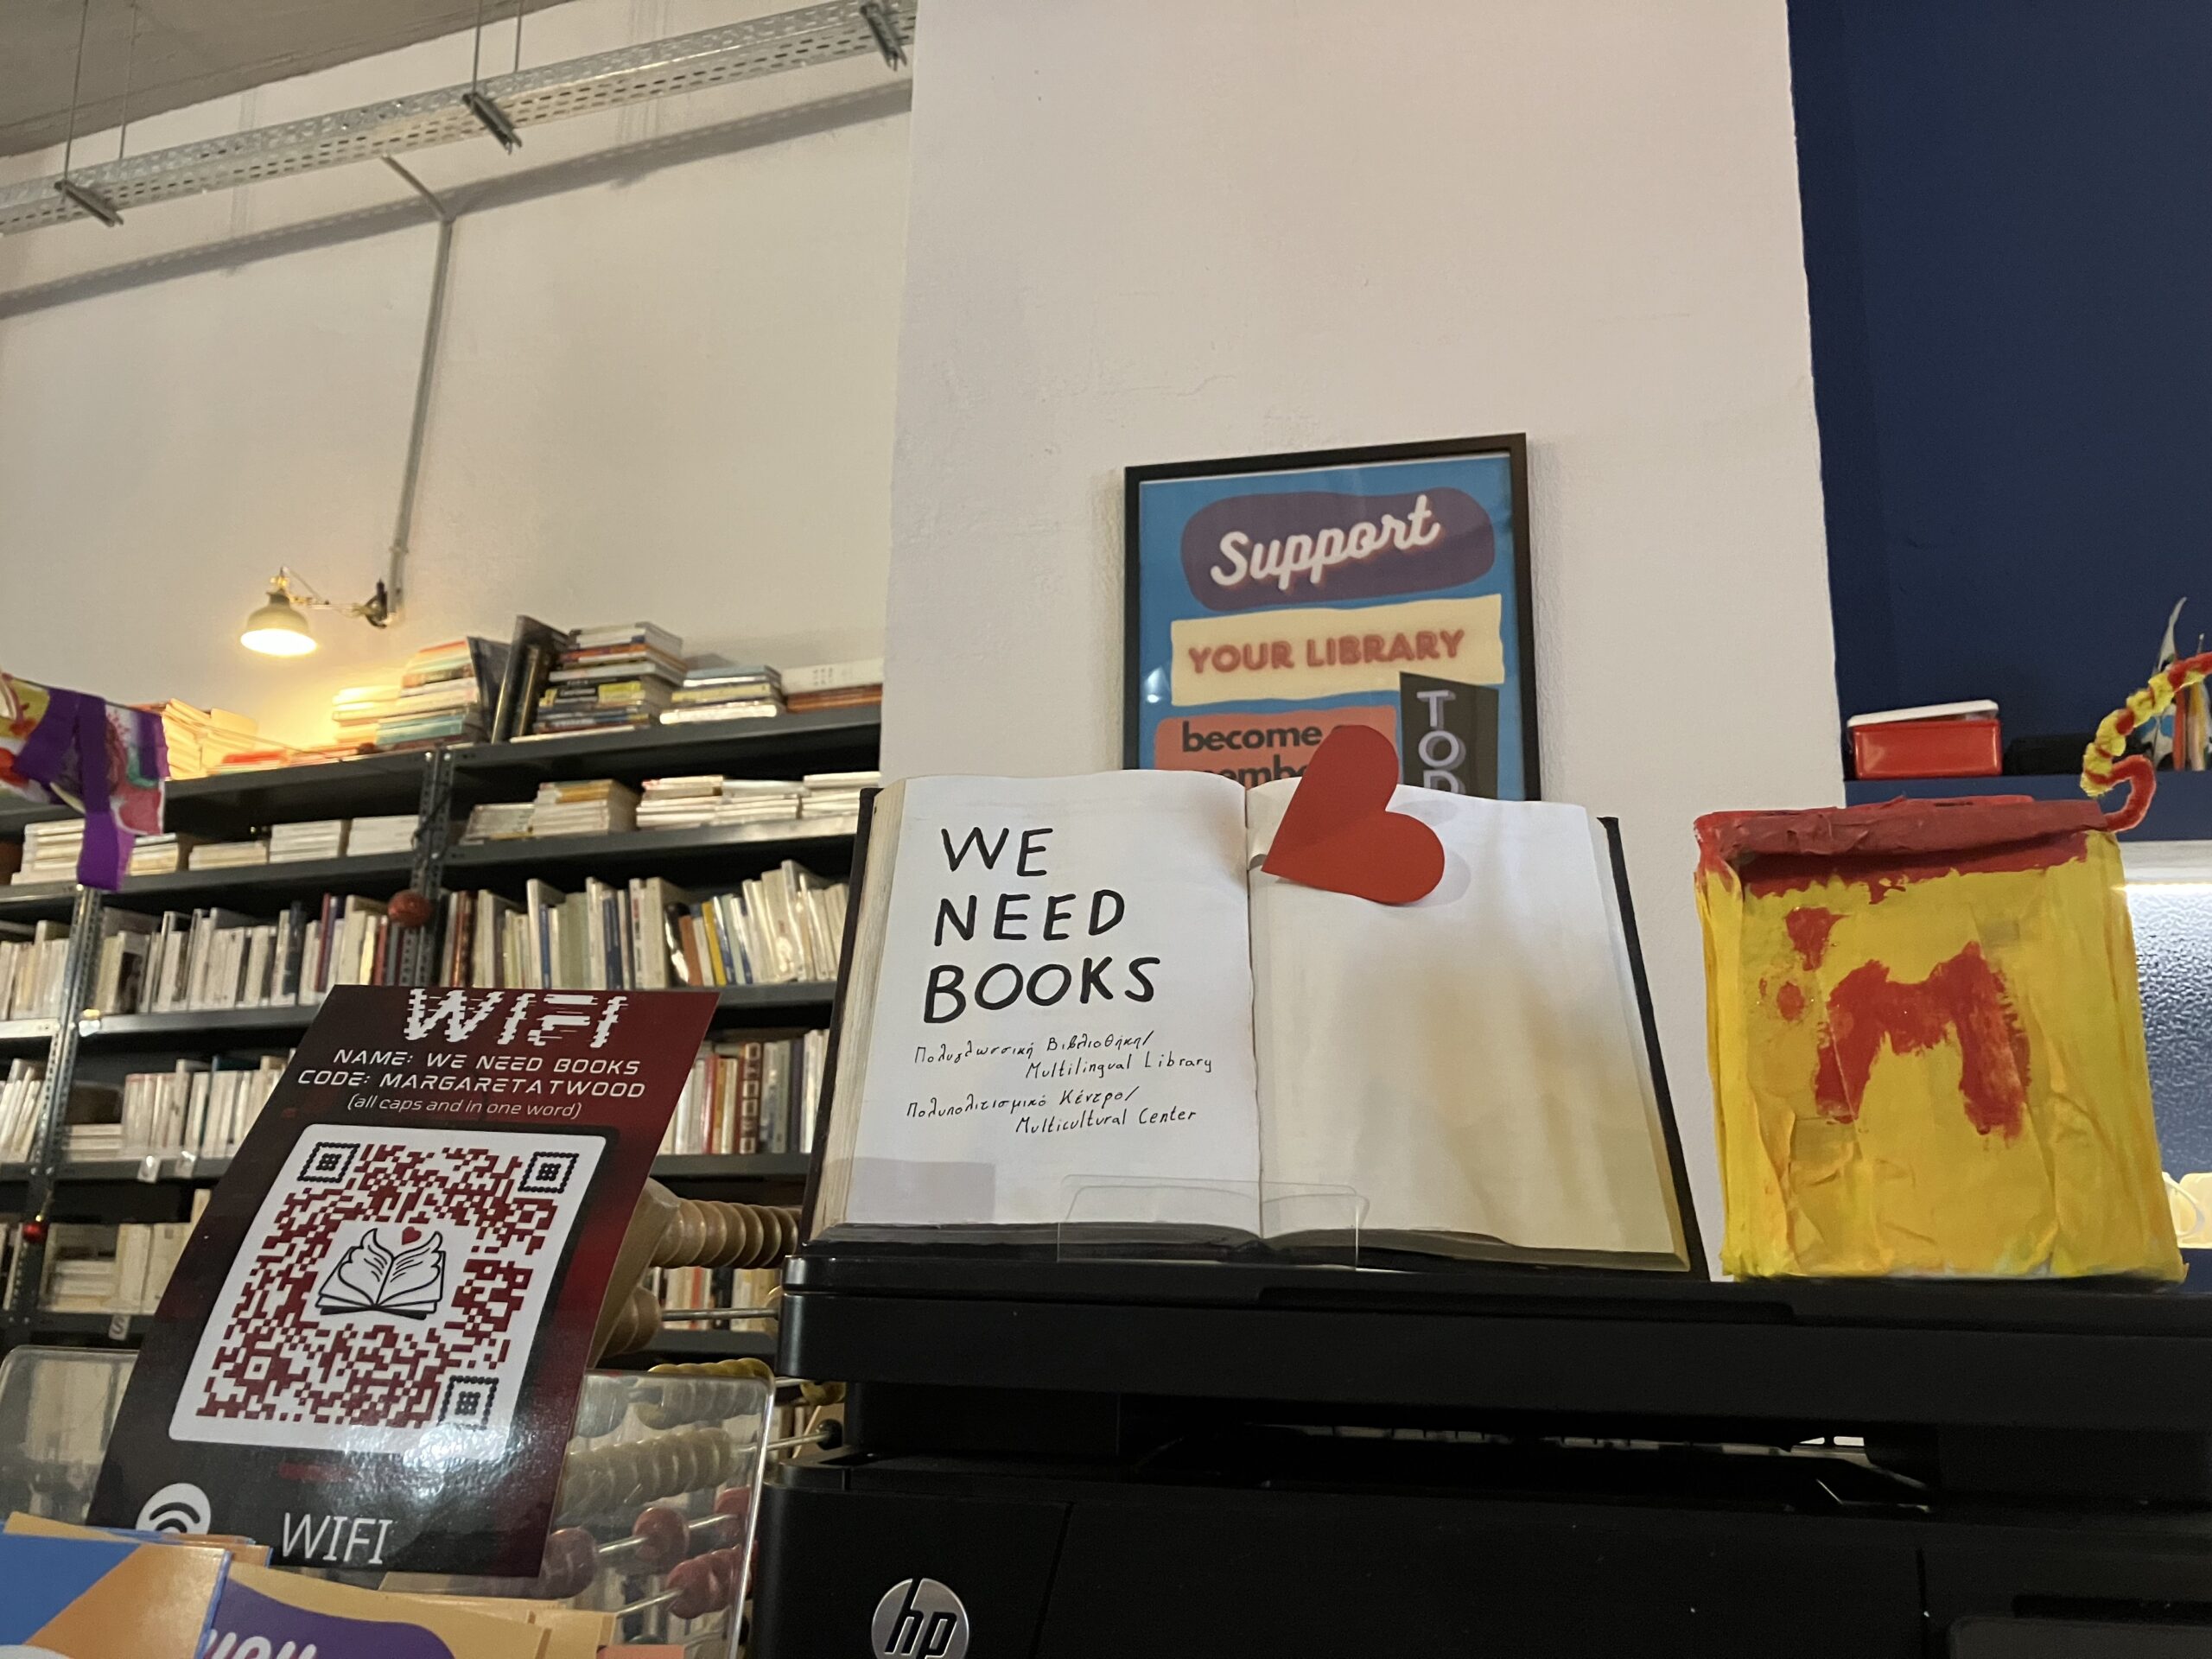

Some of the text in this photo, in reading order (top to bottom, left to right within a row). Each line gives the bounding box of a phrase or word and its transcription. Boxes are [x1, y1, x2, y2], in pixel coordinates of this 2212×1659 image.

[1211, 494, 1441, 590] Support
[1189, 629, 1465, 674] YOUR LIBRARY
[1182, 721, 1323, 753] become
[941, 827, 1053, 877] WE
[934, 889, 1125, 947] NEED
[924, 956, 1160, 1024] BOOKS
[404, 988, 629, 1049] WIFI
[333, 1049, 641, 1076] NAME: WE NEED BOOKS
[914, 1030, 1154, 1064] Πολυγλωσσική Βιβλιοθήκη/
[1026, 1050, 1212, 1078] Multilingual Library
[297, 1069, 645, 1098] CODE: MARGARETATWOOD
[906, 1085, 1140, 1118] Πολυπολιτισμικό Κέντρο/
[346, 1092, 582, 1120] (all caps and in one word)
[1015, 1105, 1197, 1134] Multicultural Center
[283, 1512, 393, 1565] WIFI
[884, 1578, 957, 1659] hp
